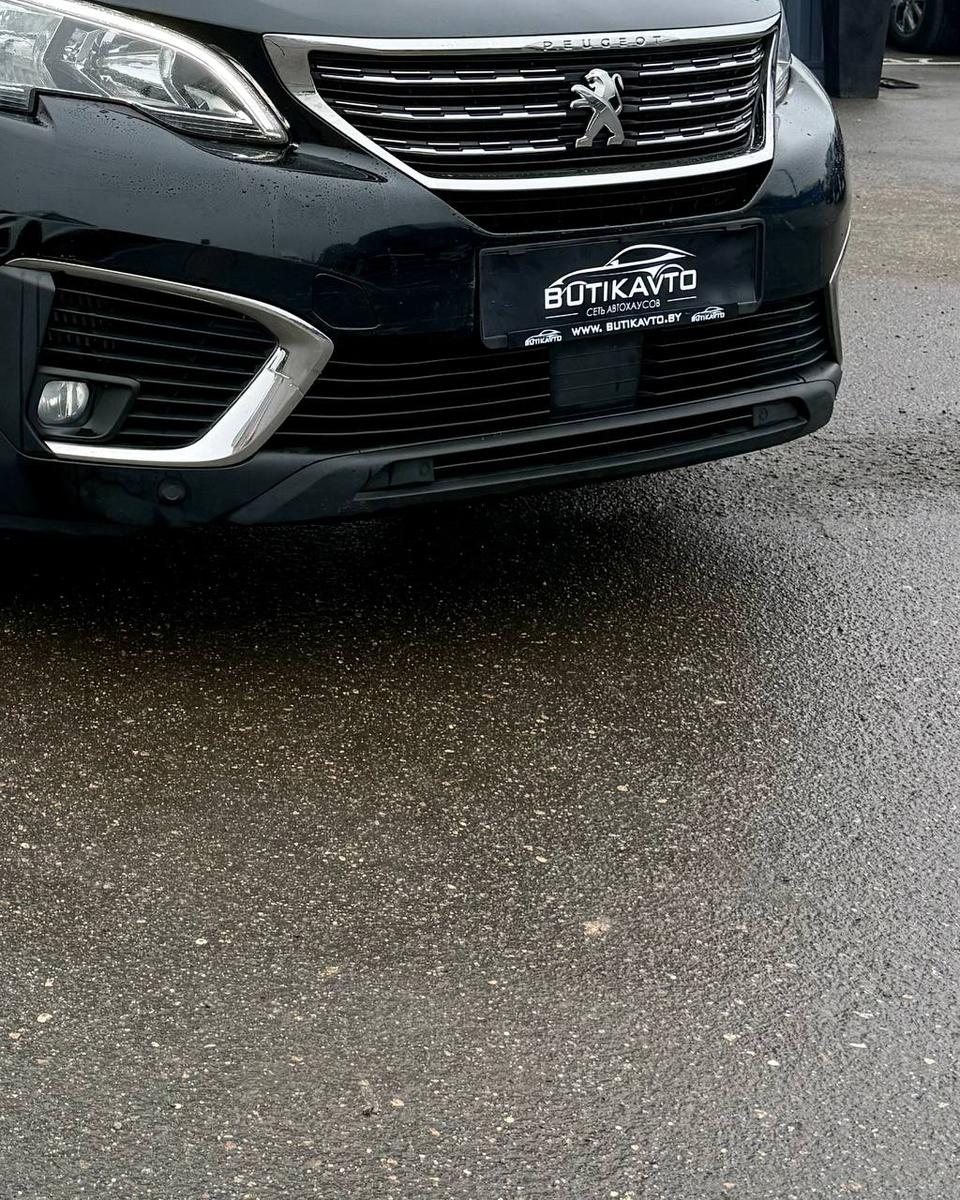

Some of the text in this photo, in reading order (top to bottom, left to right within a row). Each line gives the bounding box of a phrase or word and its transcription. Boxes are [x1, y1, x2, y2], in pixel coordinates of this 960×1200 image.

[542, 35, 662, 51] PEUGEOT
[544, 269, 697, 310] BUTIKAVTO
[586, 298, 661, 317] СЕТЬ АВТОХАУСОВ
[571, 312, 683, 337] WWW. BUTIKAVTO.BY
